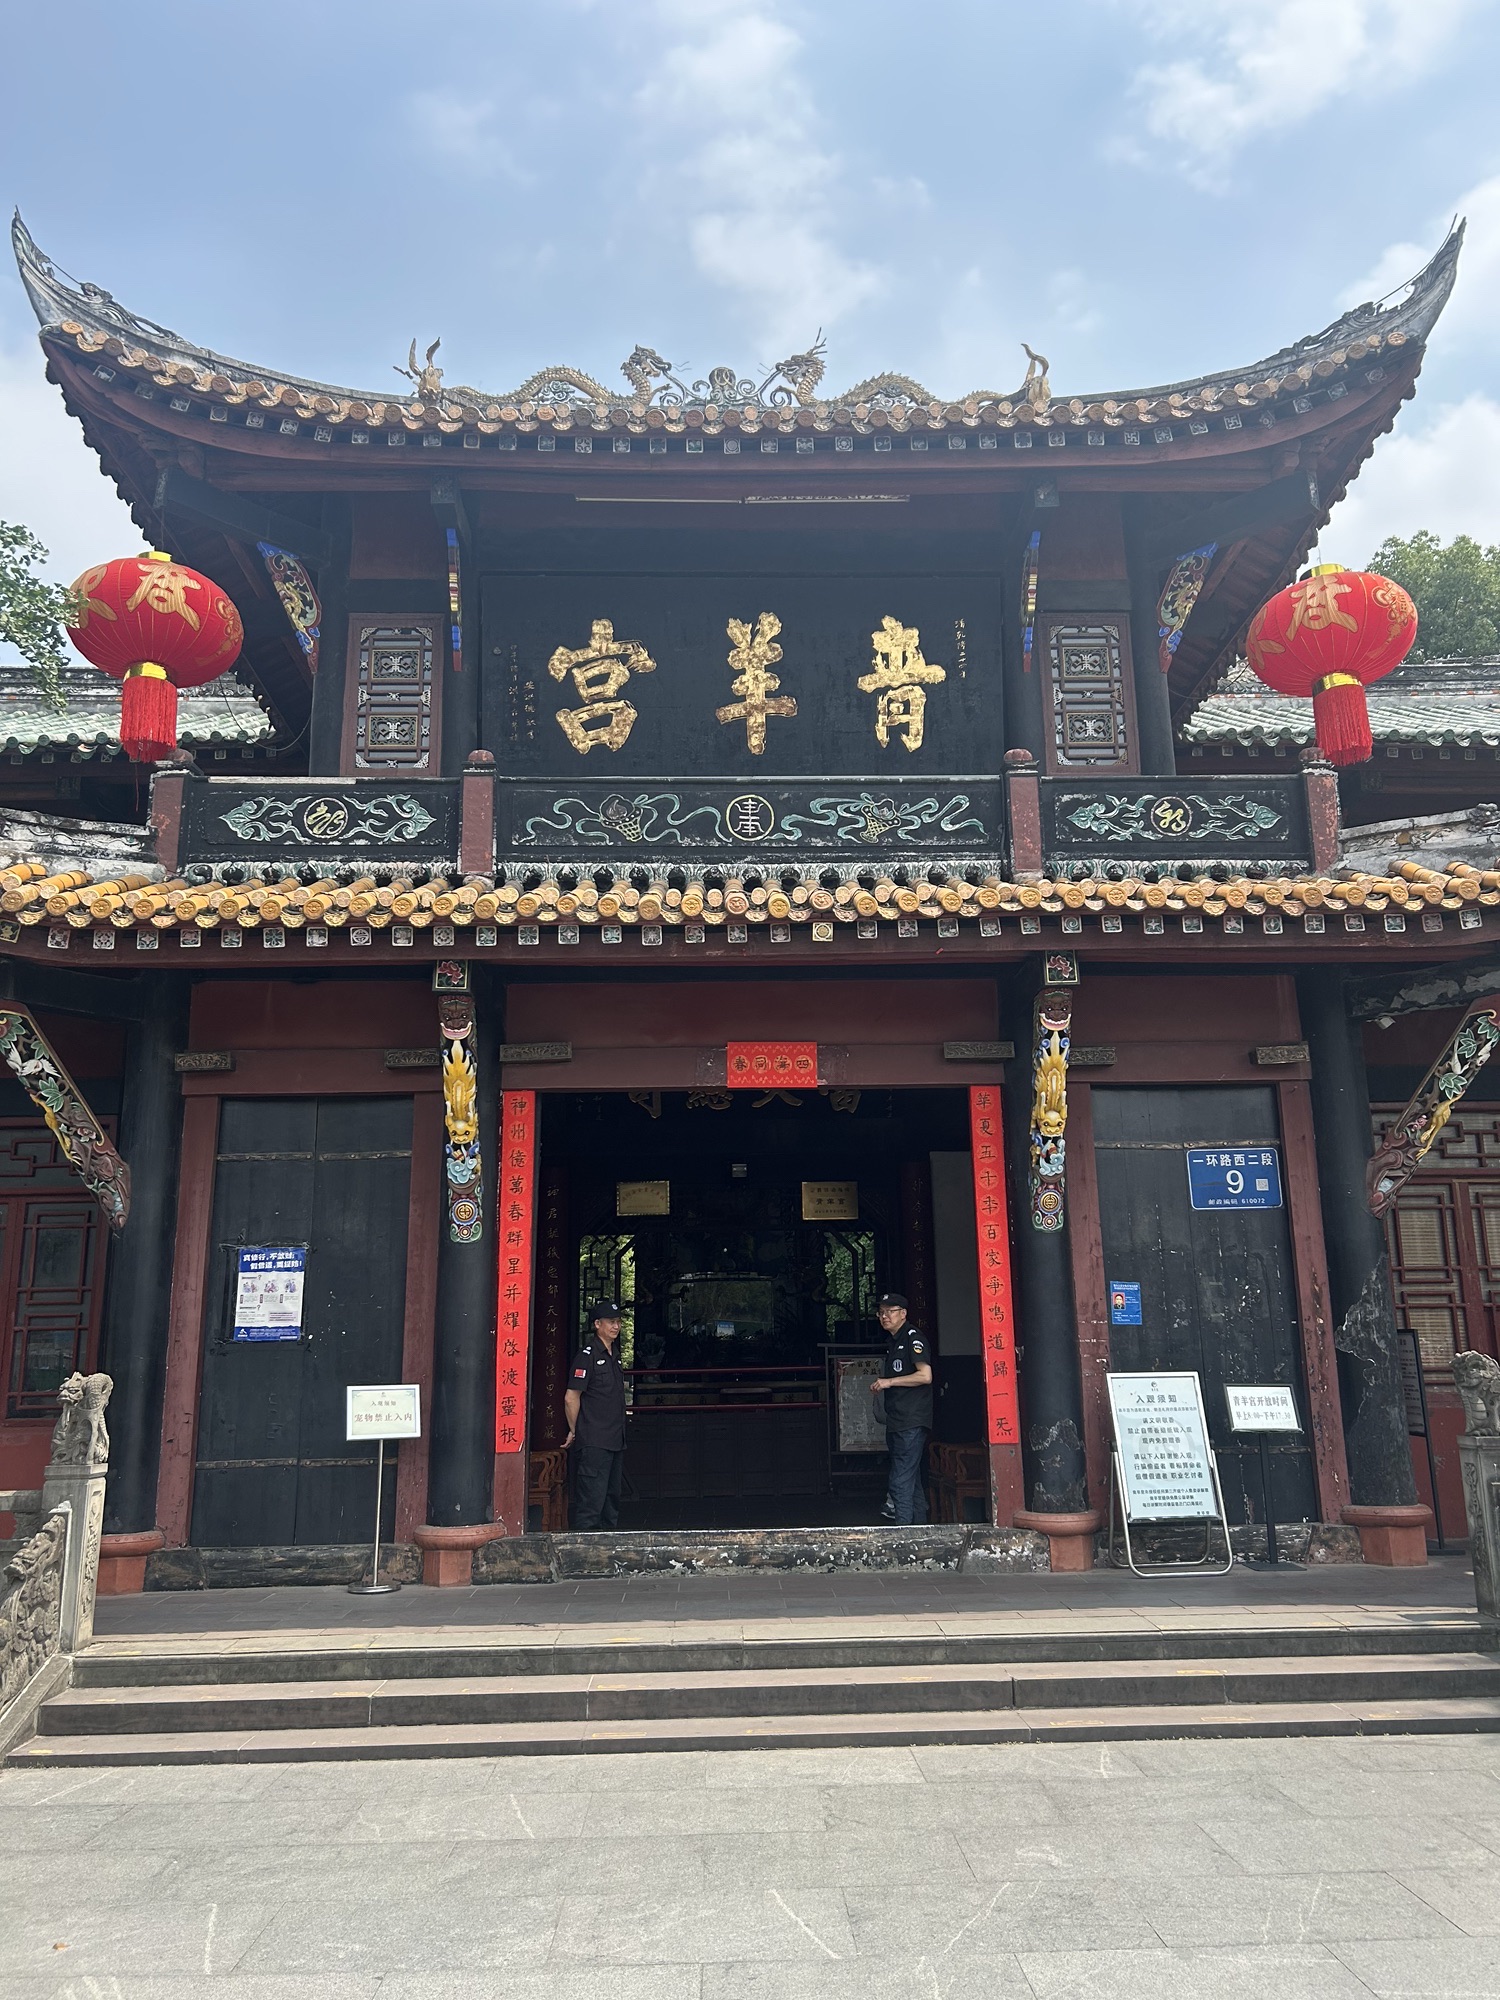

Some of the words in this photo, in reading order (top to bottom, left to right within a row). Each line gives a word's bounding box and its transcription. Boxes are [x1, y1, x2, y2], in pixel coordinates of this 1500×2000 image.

[733, 1055, 810, 1072] 四海同春
[1192, 1152, 1274, 1167] 一环路西二段
[1225, 1169, 1245, 1195] 9
[1208, 1198, 1238, 1206] 邮政编码
[1241, 1197, 1266, 1205] 610072
[1135, 1394, 1178, 1404] 入观须知
[1232, 1395, 1290, 1407] 青羊宫开放时间
[354, 1412, 413, 1423] 宠物禁止入内
